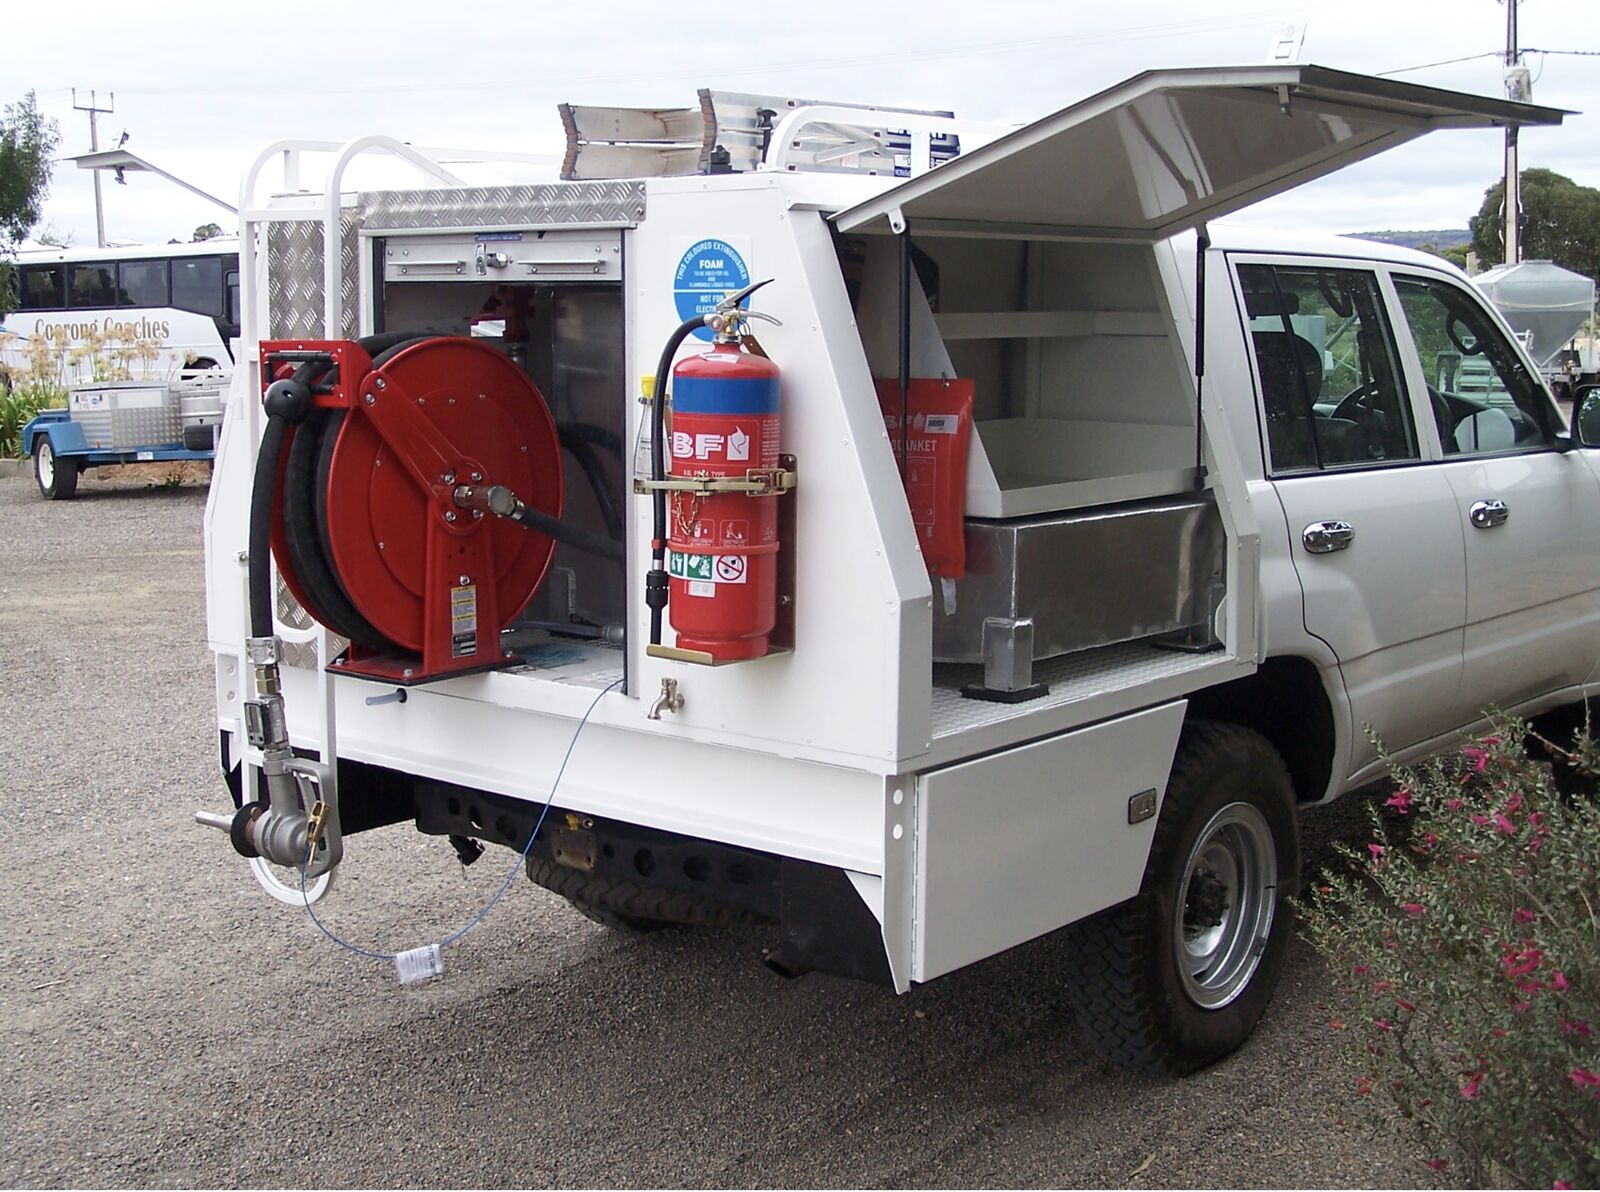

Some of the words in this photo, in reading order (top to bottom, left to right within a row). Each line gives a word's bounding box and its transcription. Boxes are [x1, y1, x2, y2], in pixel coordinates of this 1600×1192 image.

[676, 263, 687, 280] THIS
[684, 241, 712, 264] COLOURED
[713, 241, 748, 280] EXTINGUISHER
[699, 259, 724, 269] FOAM
[700, 295, 711, 303] NOT
[695, 305, 717, 314] ELECTR
[103, 316, 170, 339] Coches
